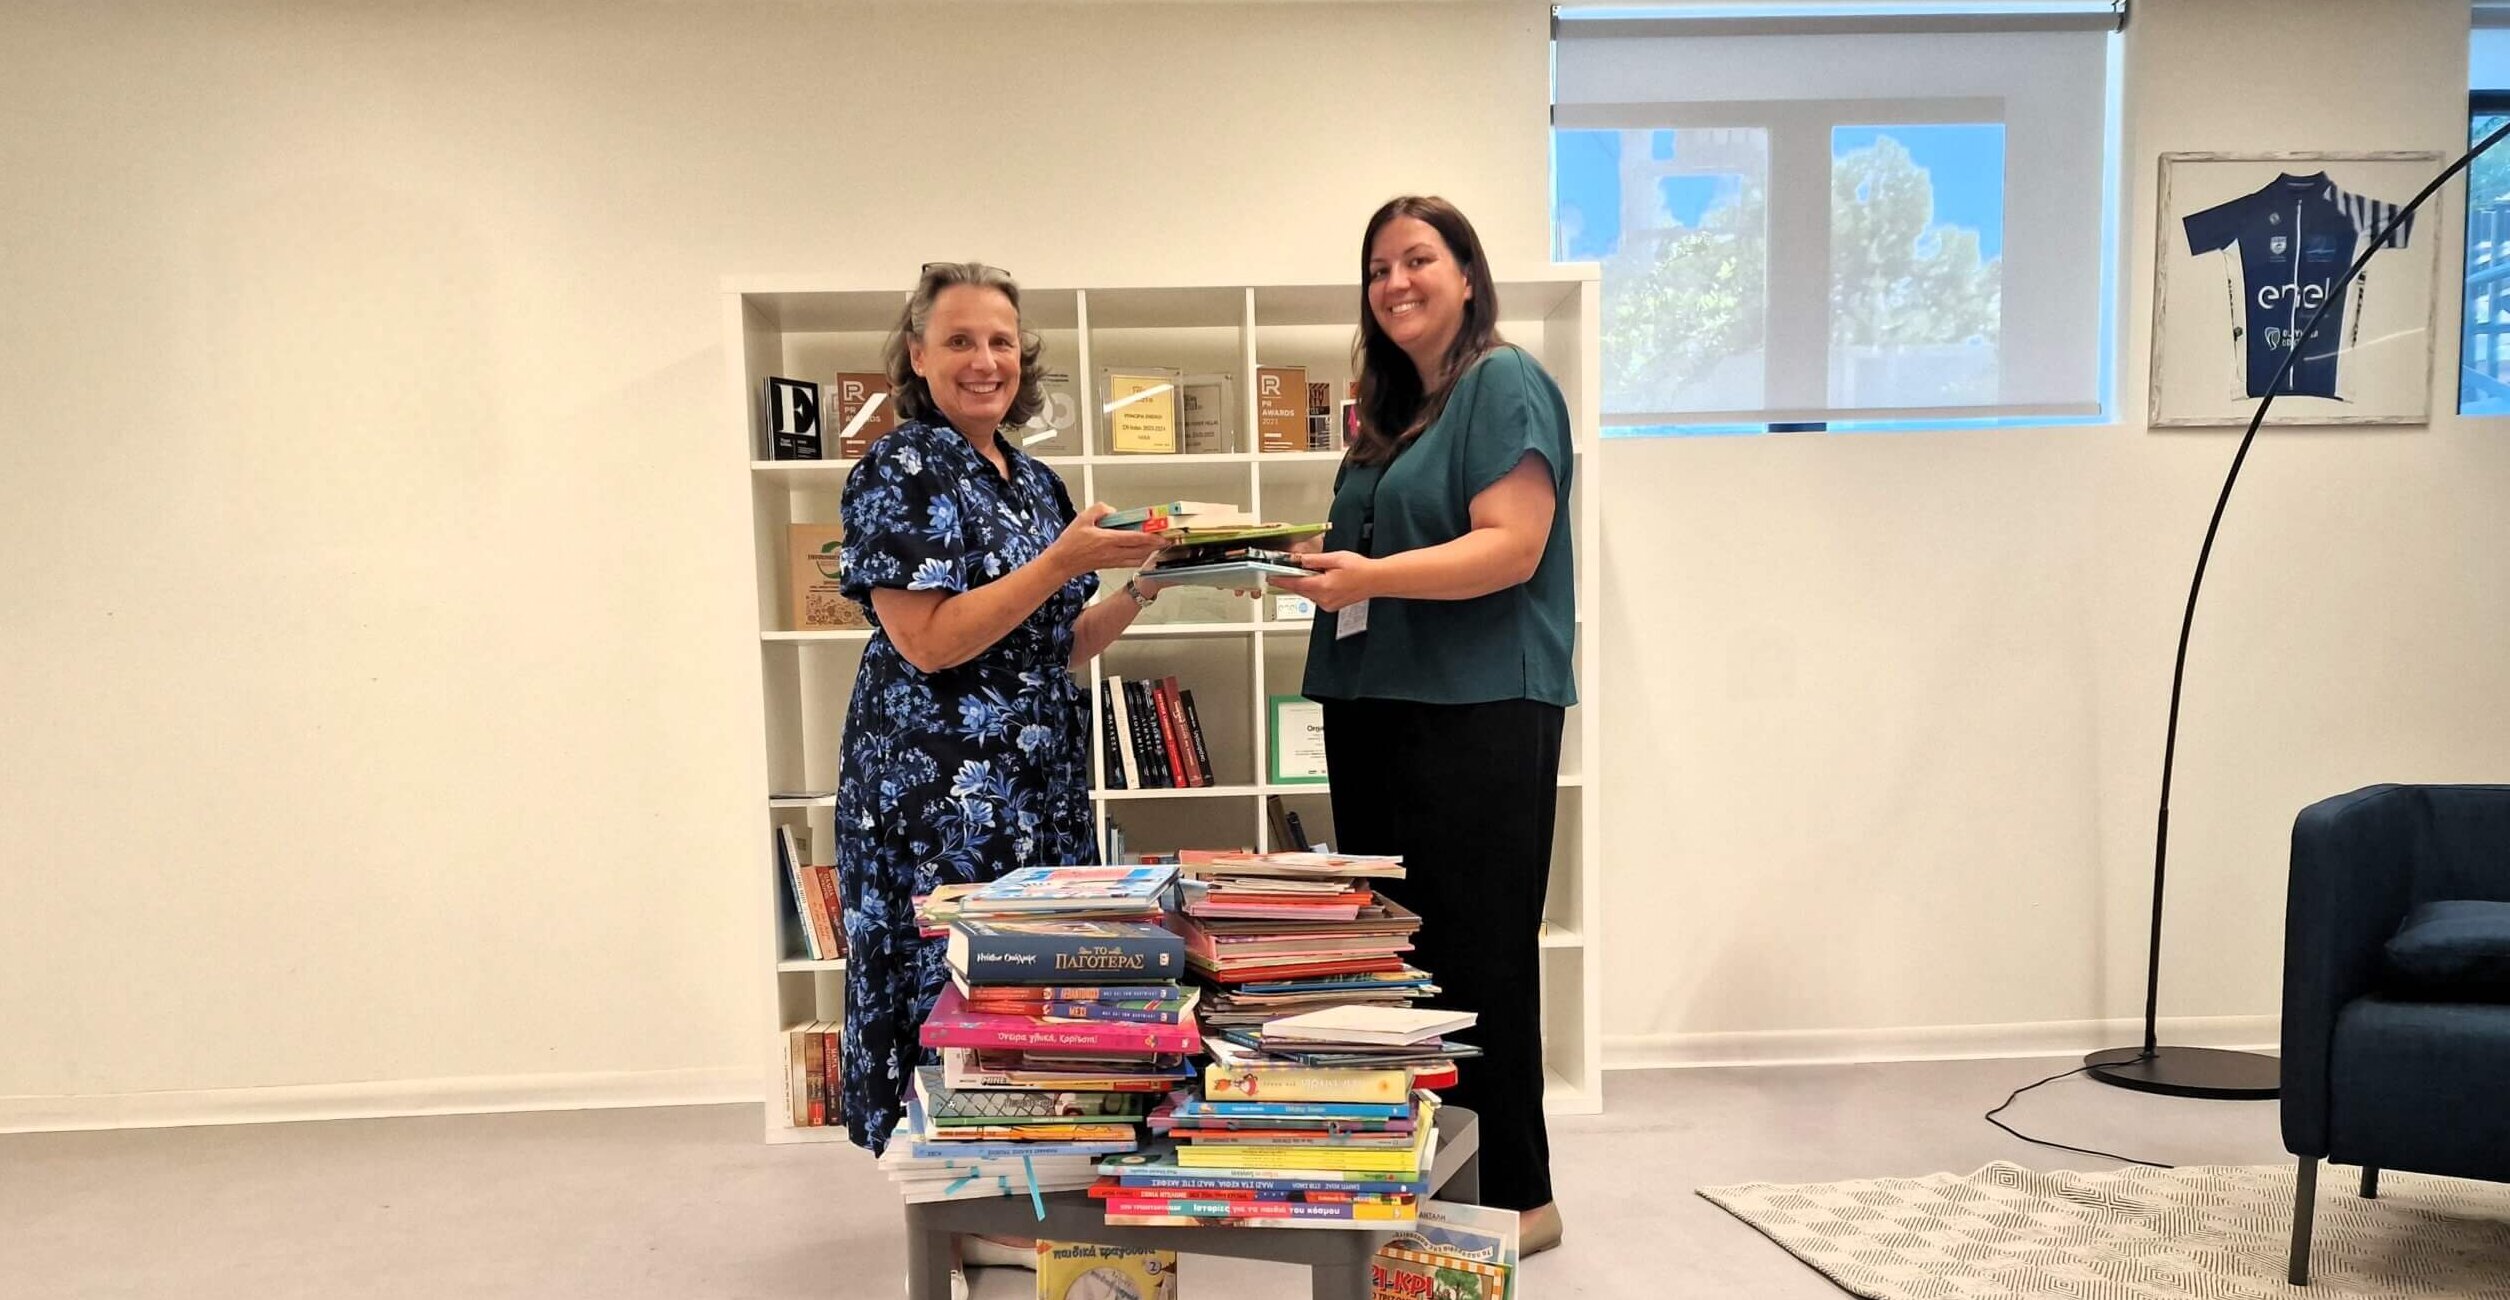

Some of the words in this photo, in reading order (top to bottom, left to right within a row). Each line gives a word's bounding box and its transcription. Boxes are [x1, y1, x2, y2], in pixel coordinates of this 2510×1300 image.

[2257, 277, 2330, 309] enel
[1262, 409, 1295, 417] AWARDS
[1093, 946, 1108, 955] ΤΟ
[1055, 953, 1144, 970] ΠΑΓΟΤΕΡΑΣ
[1198, 1180, 1216, 1188] ΜΑΖΙ
[1241, 1181, 1254, 1189] ΣΤΑ
[1193, 1202, 1231, 1214] Ιστορίες
[1248, 1205, 1258, 1213] τα
[1289, 1206, 1305, 1214] του
[1307, 1206, 1341, 1216] κόσμου
[1053, 1245, 1097, 1260] παιδικά
[1149, 1261, 1157, 1272] 2
